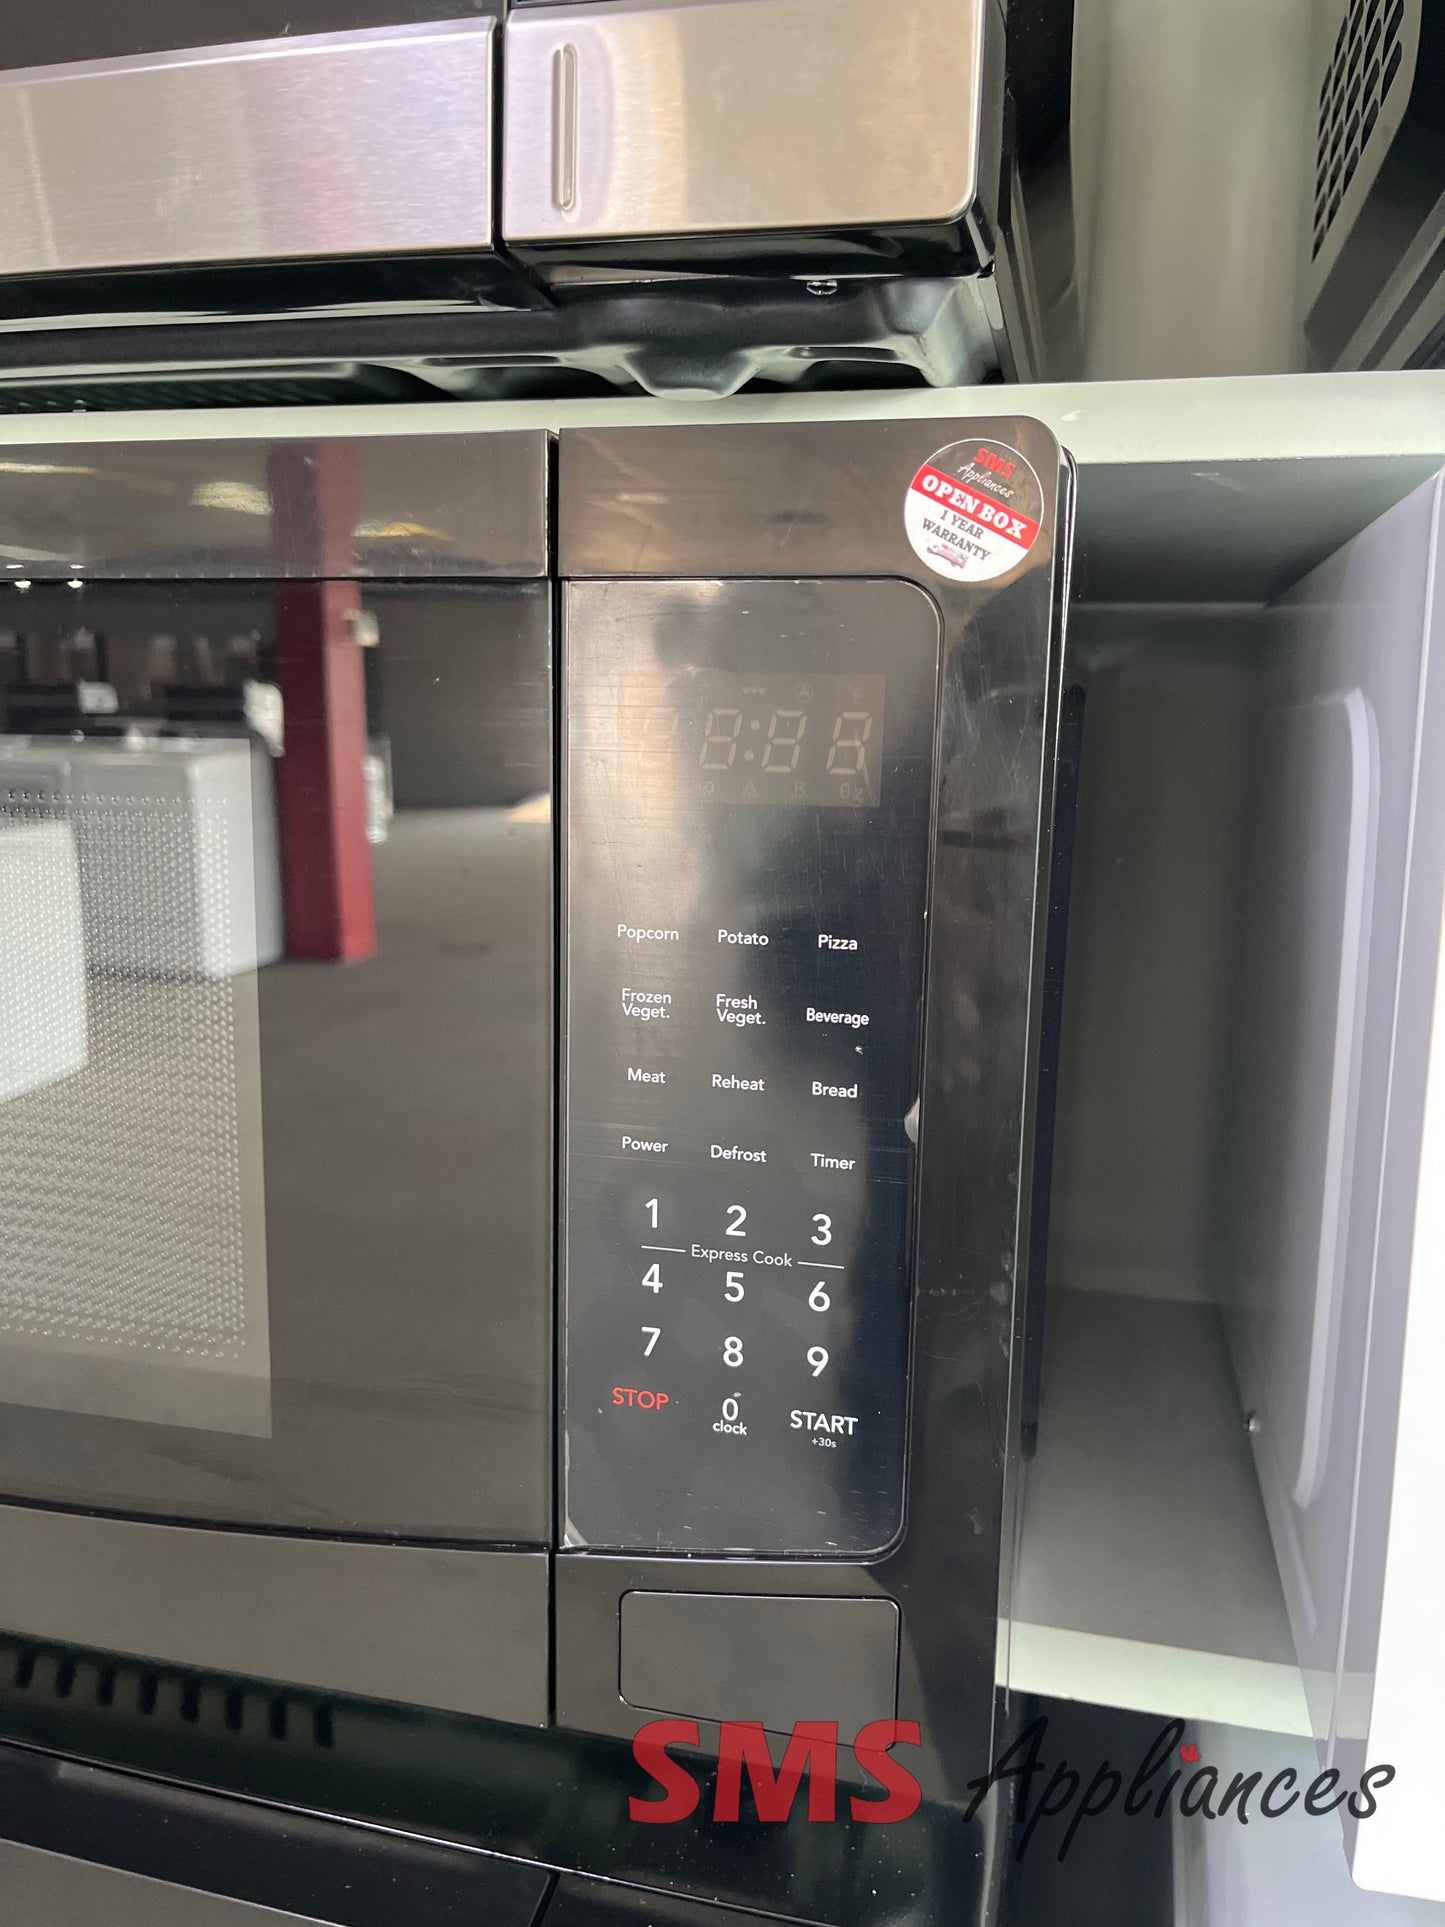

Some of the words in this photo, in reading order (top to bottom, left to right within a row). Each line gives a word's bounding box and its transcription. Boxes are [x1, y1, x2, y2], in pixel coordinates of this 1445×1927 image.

[973, 448, 1016, 479] SMS
[957, 462, 1014, 498] Appliances
[922, 474, 979, 513] OPEN
[977, 498, 1027, 539] BOX
[940, 509, 948, 521] 1
[950, 514, 984, 540] YEAR
[922, 517, 991, 561] WARRANTY
[617, 924, 679, 943] Popcorn
[718, 929, 769, 946] Potato
[818, 935, 858, 950] Pizza
[622, 988, 671, 1004] Frozen
[716, 994, 757, 1010] Fresh
[622, 1003, 670, 1021] Veget.
[716, 1009, 766, 1027] Veget.
[806, 1008, 869, 1028] Beverage
[627, 1068, 665, 1084] Meat
[712, 1074, 764, 1091] Reheat
[812, 1081, 858, 1098] Bread
[622, 1136, 668, 1153] Power
[710, 1145, 767, 1163] Defrost
[810, 1153, 855, 1170] Timer
[645, 1198, 658, 1229] 1
[725, 1204, 747, 1237] 2
[810, 1213, 832, 1246] 3
[691, 1244, 748, 1263] Express
[753, 1250, 792, 1267] Cook
[641, 1263, 664, 1294] 4
[723, 1271, 745, 1303] 5
[808, 1281, 831, 1312] 6
[641, 1326, 661, 1357] 7
[723, 1336, 744, 1368] 8
[806, 1346, 829, 1377] 9
[612, 1387, 669, 1411] STOP
[722, 1398, 739, 1421] 0
[712, 1419, 748, 1436] clock
[789, 1409, 859, 1436] START
[811, 1436, 837, 1448] +30s
